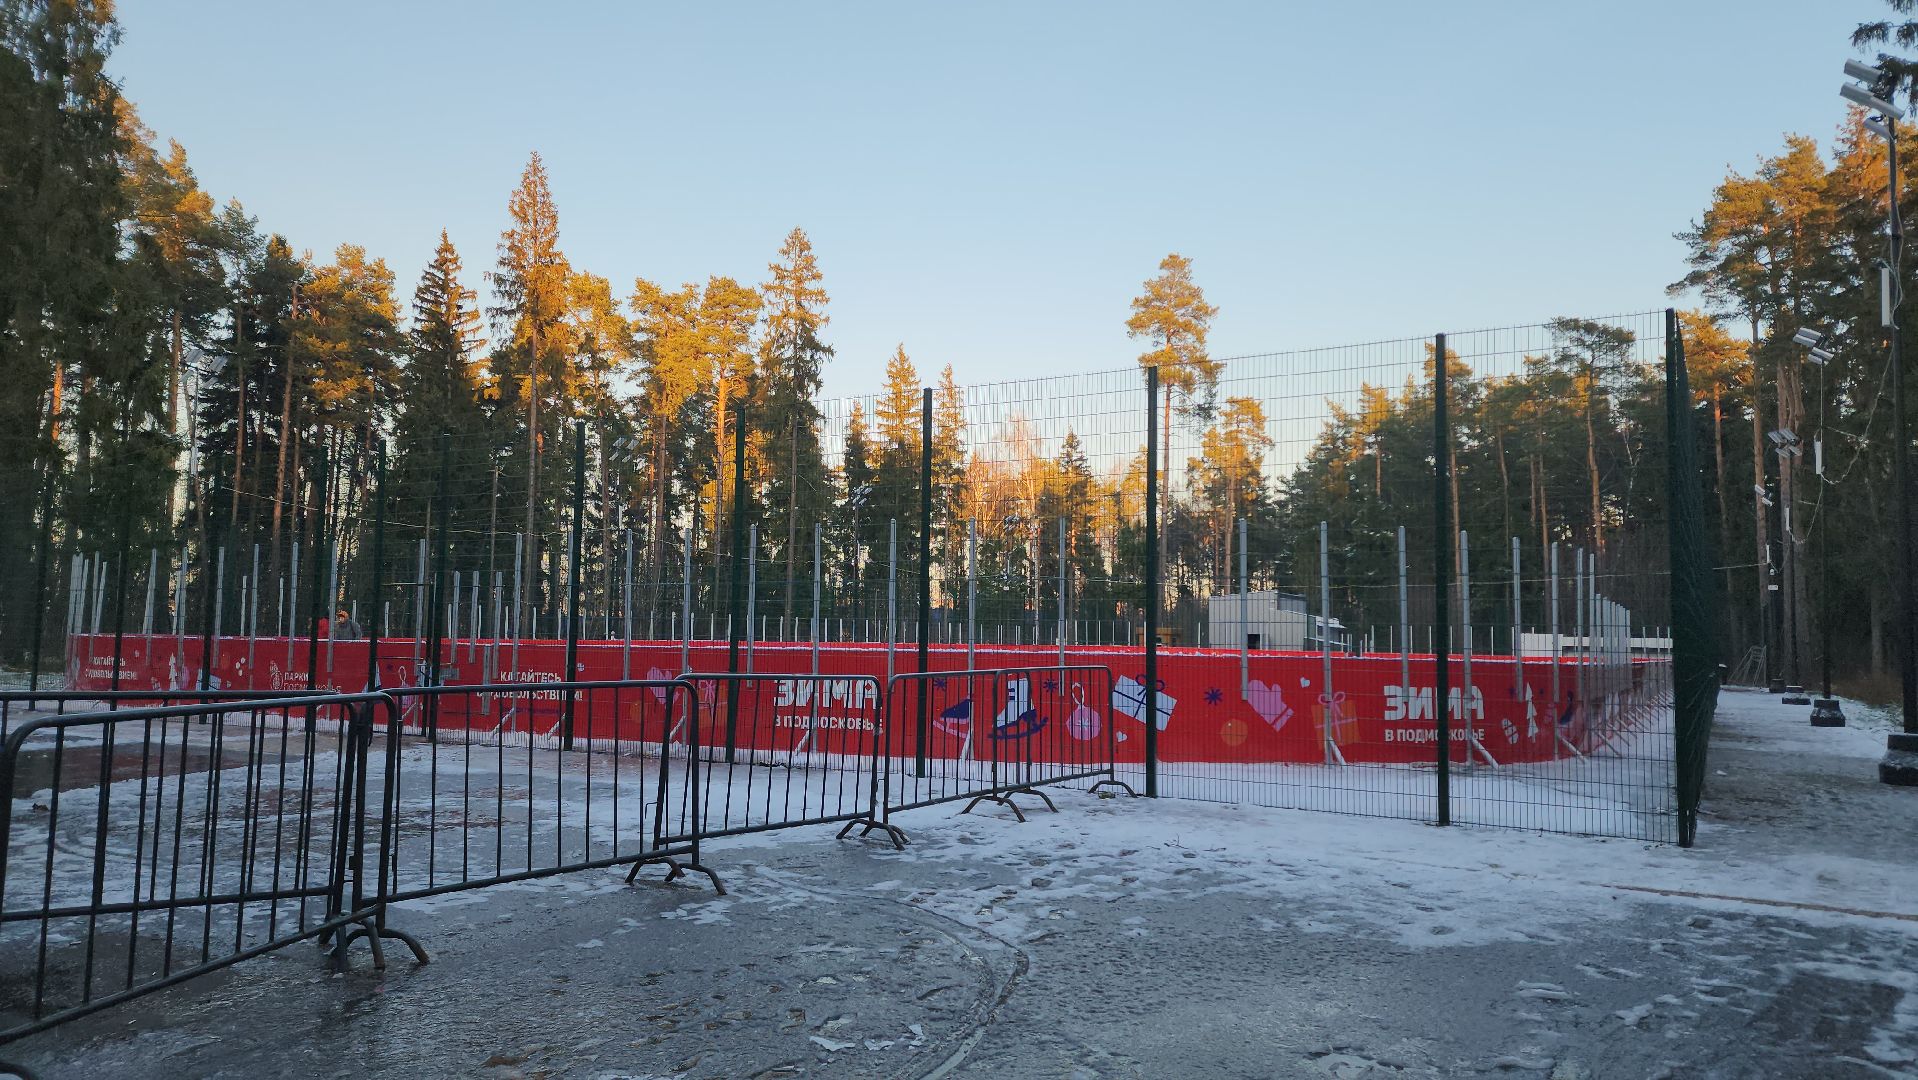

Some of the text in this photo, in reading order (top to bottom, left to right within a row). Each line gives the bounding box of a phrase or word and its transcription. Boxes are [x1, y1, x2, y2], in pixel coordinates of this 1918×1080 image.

[774, 679, 883, 710] ЗИМА
[1383, 685, 1485, 720] ЗИМА
[1385, 728, 1485, 743] В ПОДМКОЬЕ
